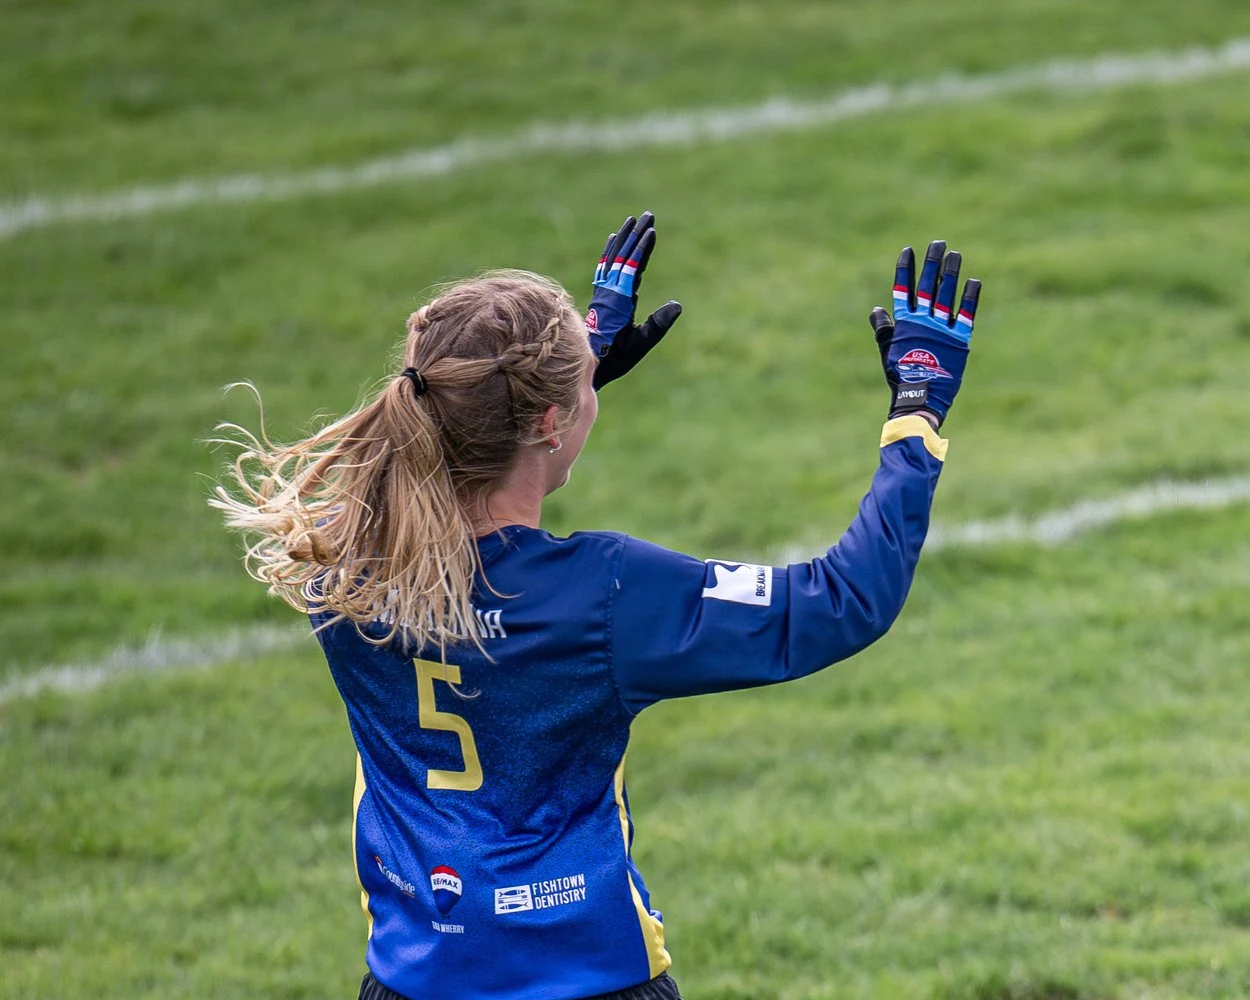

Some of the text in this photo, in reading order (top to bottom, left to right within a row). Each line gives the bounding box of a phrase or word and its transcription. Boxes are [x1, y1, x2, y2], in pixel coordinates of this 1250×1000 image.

[897, 389, 926, 400] LAYOUT
[412, 657, 484, 792] 5
[432, 877, 459, 889] RE/MAX
[531, 872, 586, 896] FISHTOWN
[534, 887, 587, 910] DENTISTRY
